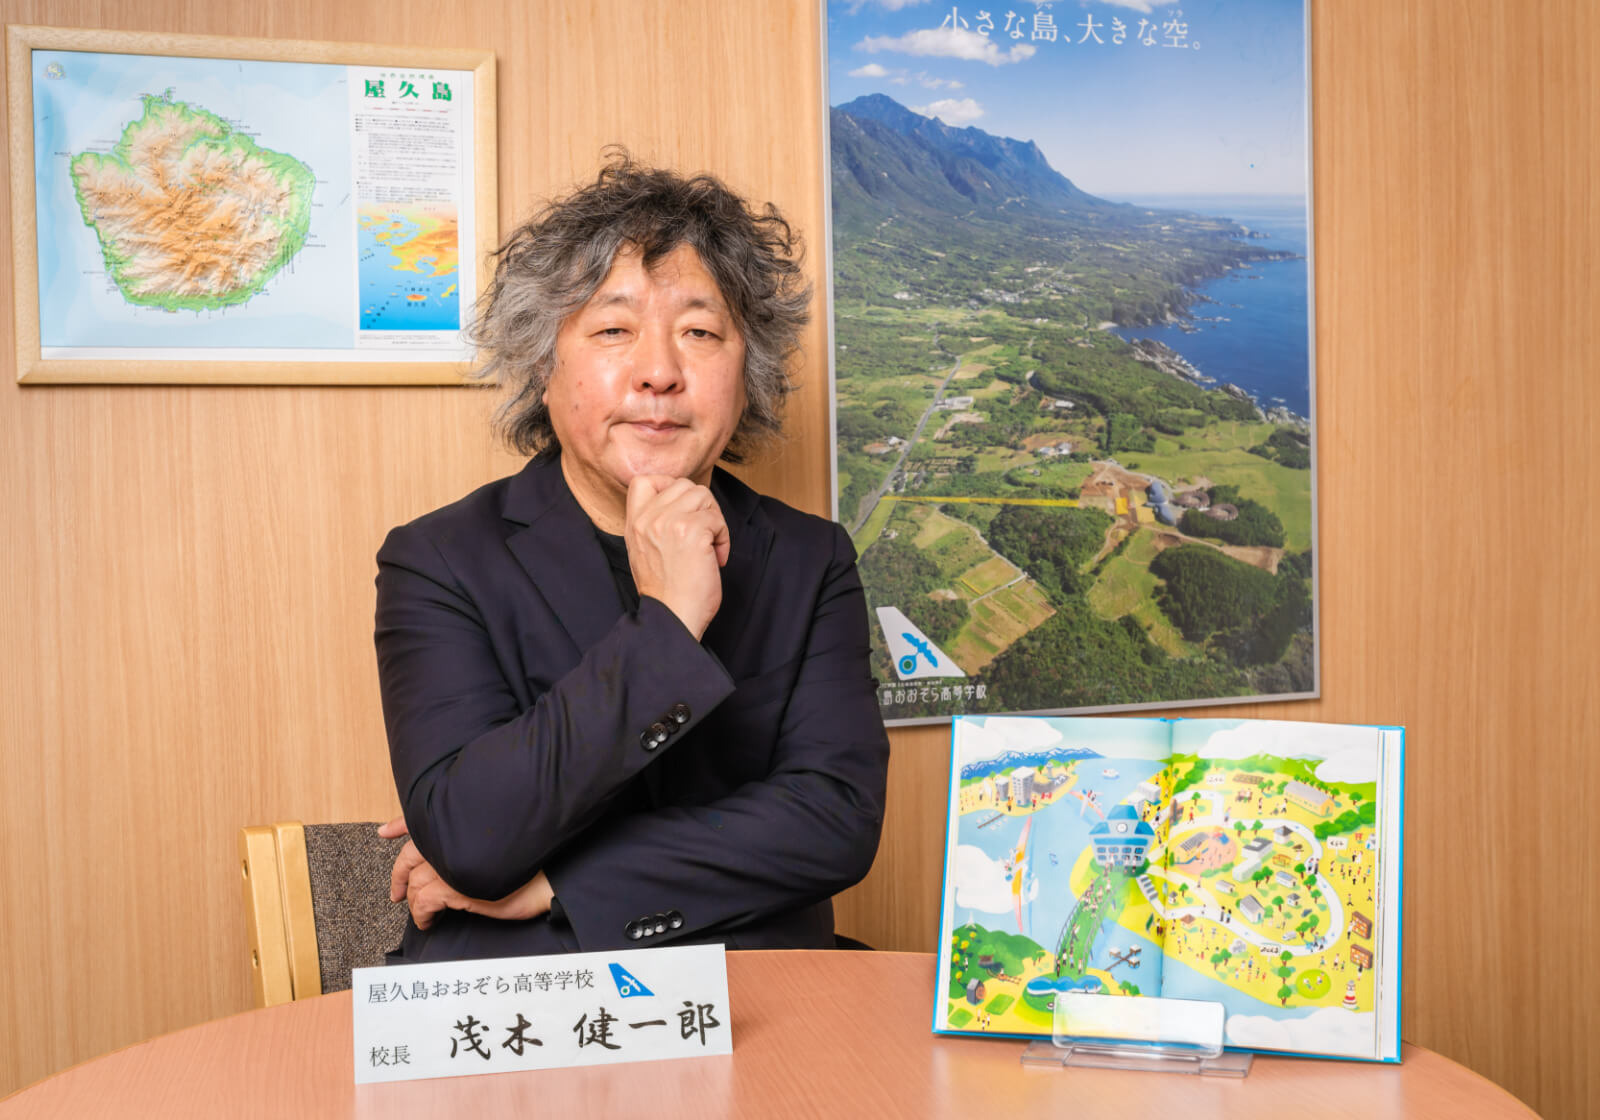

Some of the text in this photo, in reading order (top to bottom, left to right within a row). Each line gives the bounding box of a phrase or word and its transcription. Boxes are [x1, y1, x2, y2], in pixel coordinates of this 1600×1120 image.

[941, 6, 1201, 50] 小さな島、大きな空。
[364, 79, 452, 102] 屋久島
[877, 684, 987, 706] 島おおぞら高等学校
[368, 968, 595, 1004] 屋久島おおぞら高等学校
[369, 1000, 721, 1067] 校長 茂木 健一郎
